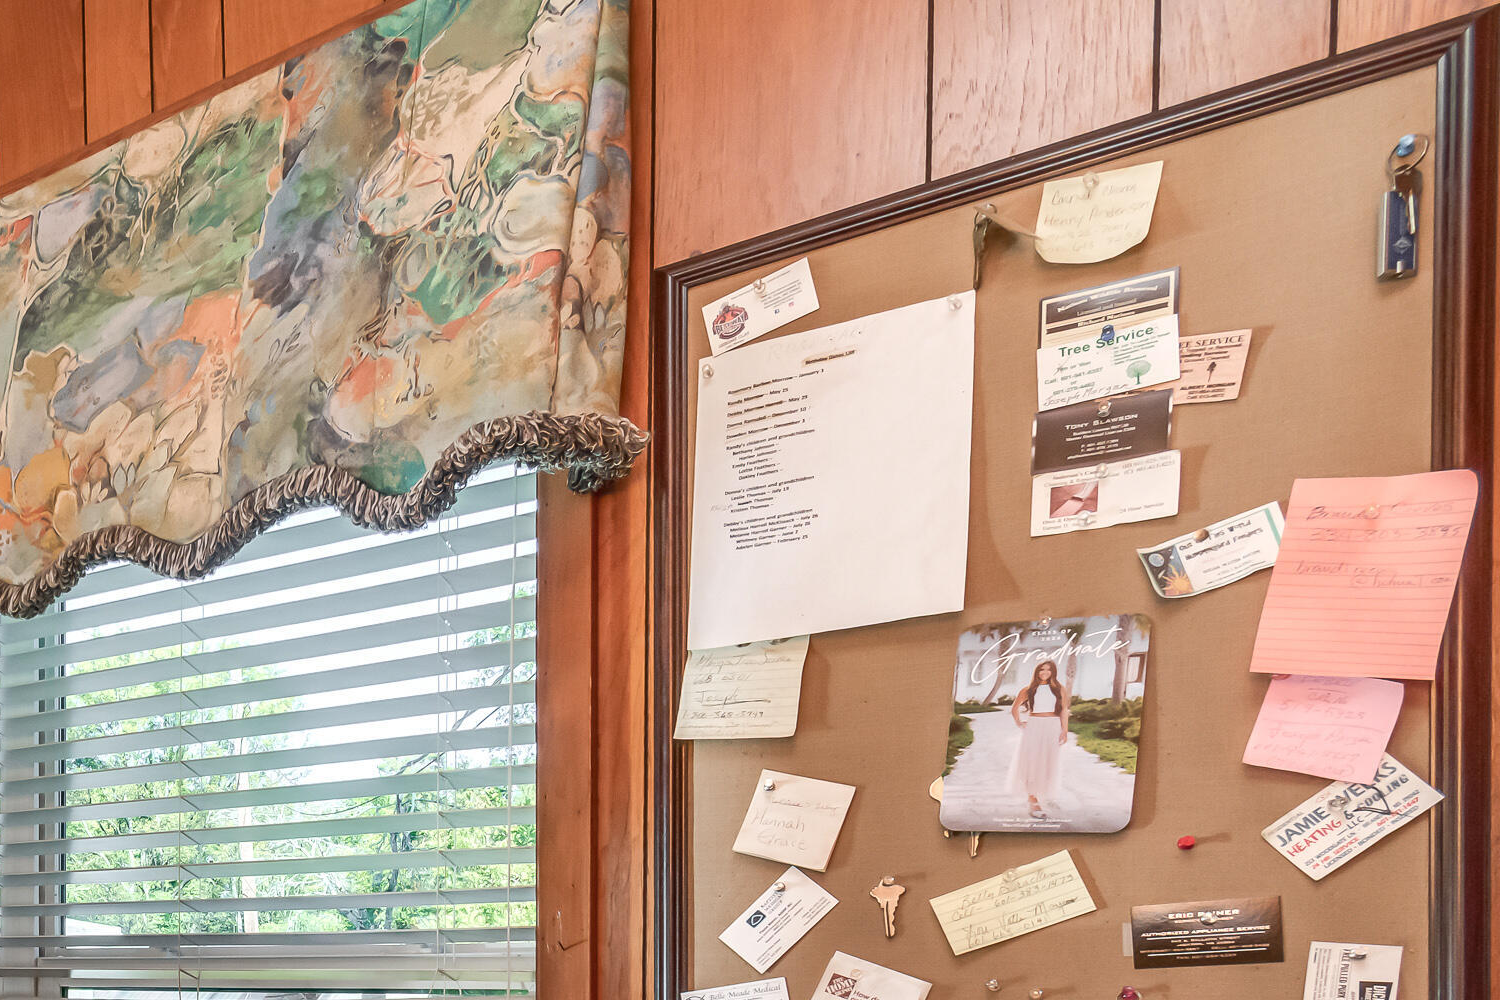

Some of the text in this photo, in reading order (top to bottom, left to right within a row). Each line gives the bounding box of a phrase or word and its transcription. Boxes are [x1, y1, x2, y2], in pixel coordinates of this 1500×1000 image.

[1057, 341, 1091, 357] Tree
[1094, 325, 1155, 348] Service
[1195, 334, 1244, 347] SERVICE
[1092, 412, 1139, 426] SLAWSON
[970, 624, 1130, 684] Graduate
[1276, 761, 1397, 847] JAMIE WEKS
[1286, 773, 1410, 857] HEATING & COOLING
[1347, 815, 1366, 831] LLC
[1331, 836, 1360, 854] SERVICE
[1339, 962, 1349, 983] PULLED
[752, 983, 781, 994] Medical
[852, 990, 870, 1000] How
